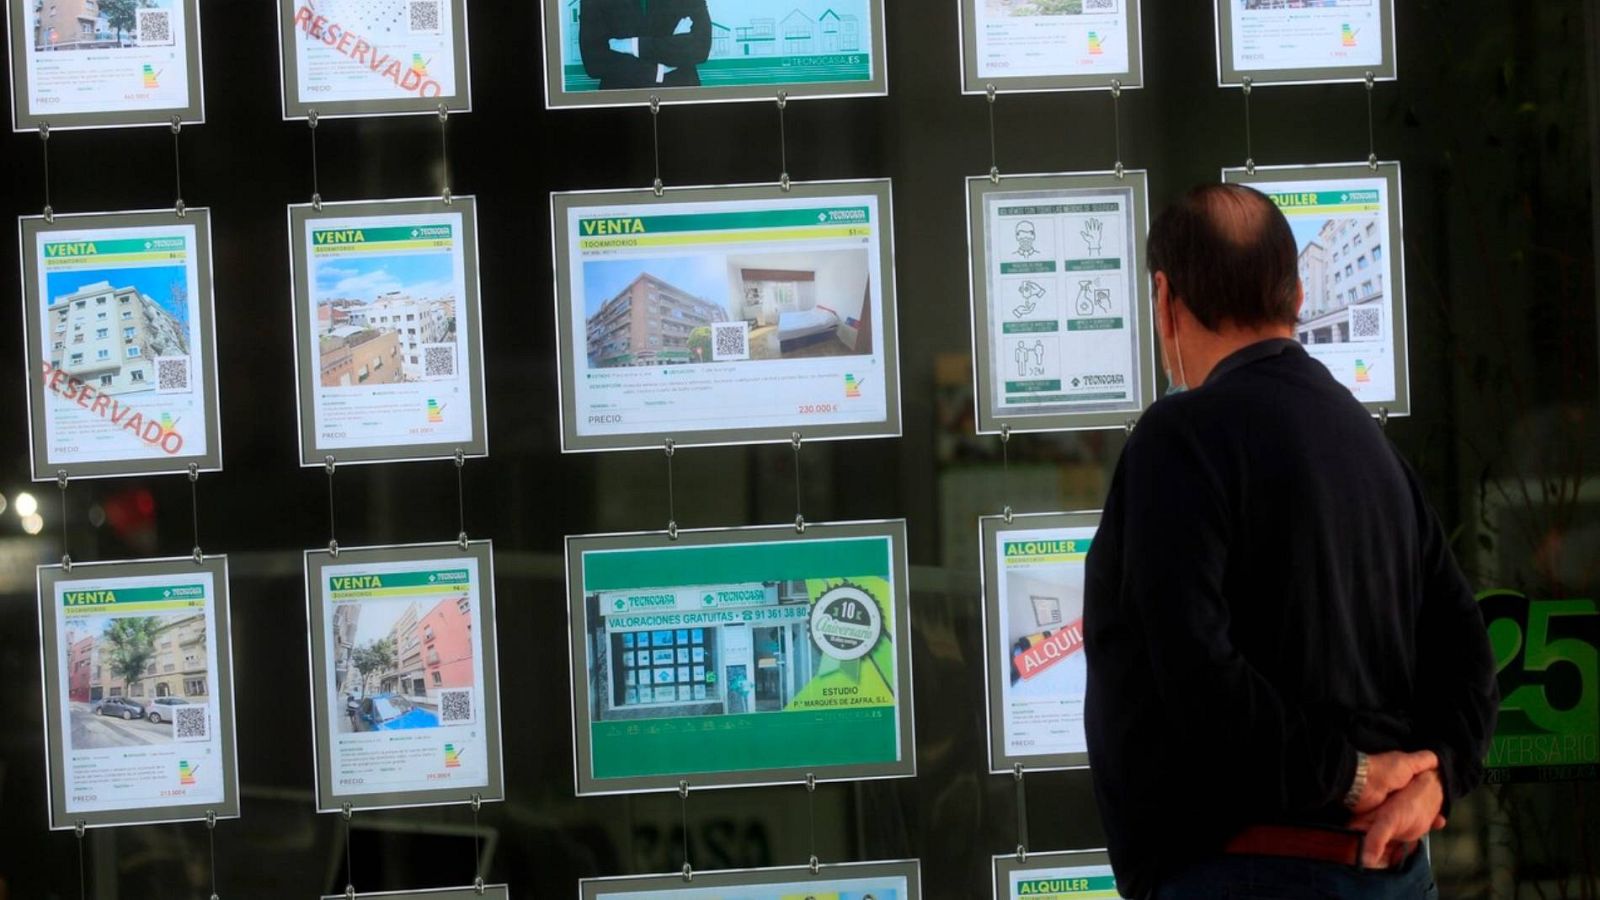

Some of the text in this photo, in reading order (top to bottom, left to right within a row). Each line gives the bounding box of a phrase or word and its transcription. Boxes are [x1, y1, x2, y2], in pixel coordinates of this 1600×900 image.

[294, 6, 442, 97] RESERVADO
[1269, 194, 1318, 206] QUILER
[583, 218, 645, 235] VENTA
[315, 230, 365, 244] VENTA
[47, 242, 97, 257] VENTA
[1083, 374, 1125, 386] TECNOCASA
[42, 360, 183, 455] RESERVADO
[1007, 541, 1077, 555] ALQUILER
[332, 575, 382, 590] VENTA
[66, 591, 116, 605] VENTA
[628, 594, 675, 607] TECNOCASA
[718, 590, 764, 603] TECNOCASA
[841, 601, 856, 619] 10
[609, 614, 680, 628] VALORACIONES
[683, 611, 734, 624] GRATUITAS
[755, 609, 765, 620] 91
[768, 608, 781, 619] 361
[1023, 626, 1084, 672] ALQUIL
[1475, 588, 1600, 735] 25
[822, 686, 859, 696] ESTUDIO
[839, 698, 849, 706] DE
[1488, 734, 1597, 765] VERSARIO
[1021, 879, 1089, 894] ALQUILER
